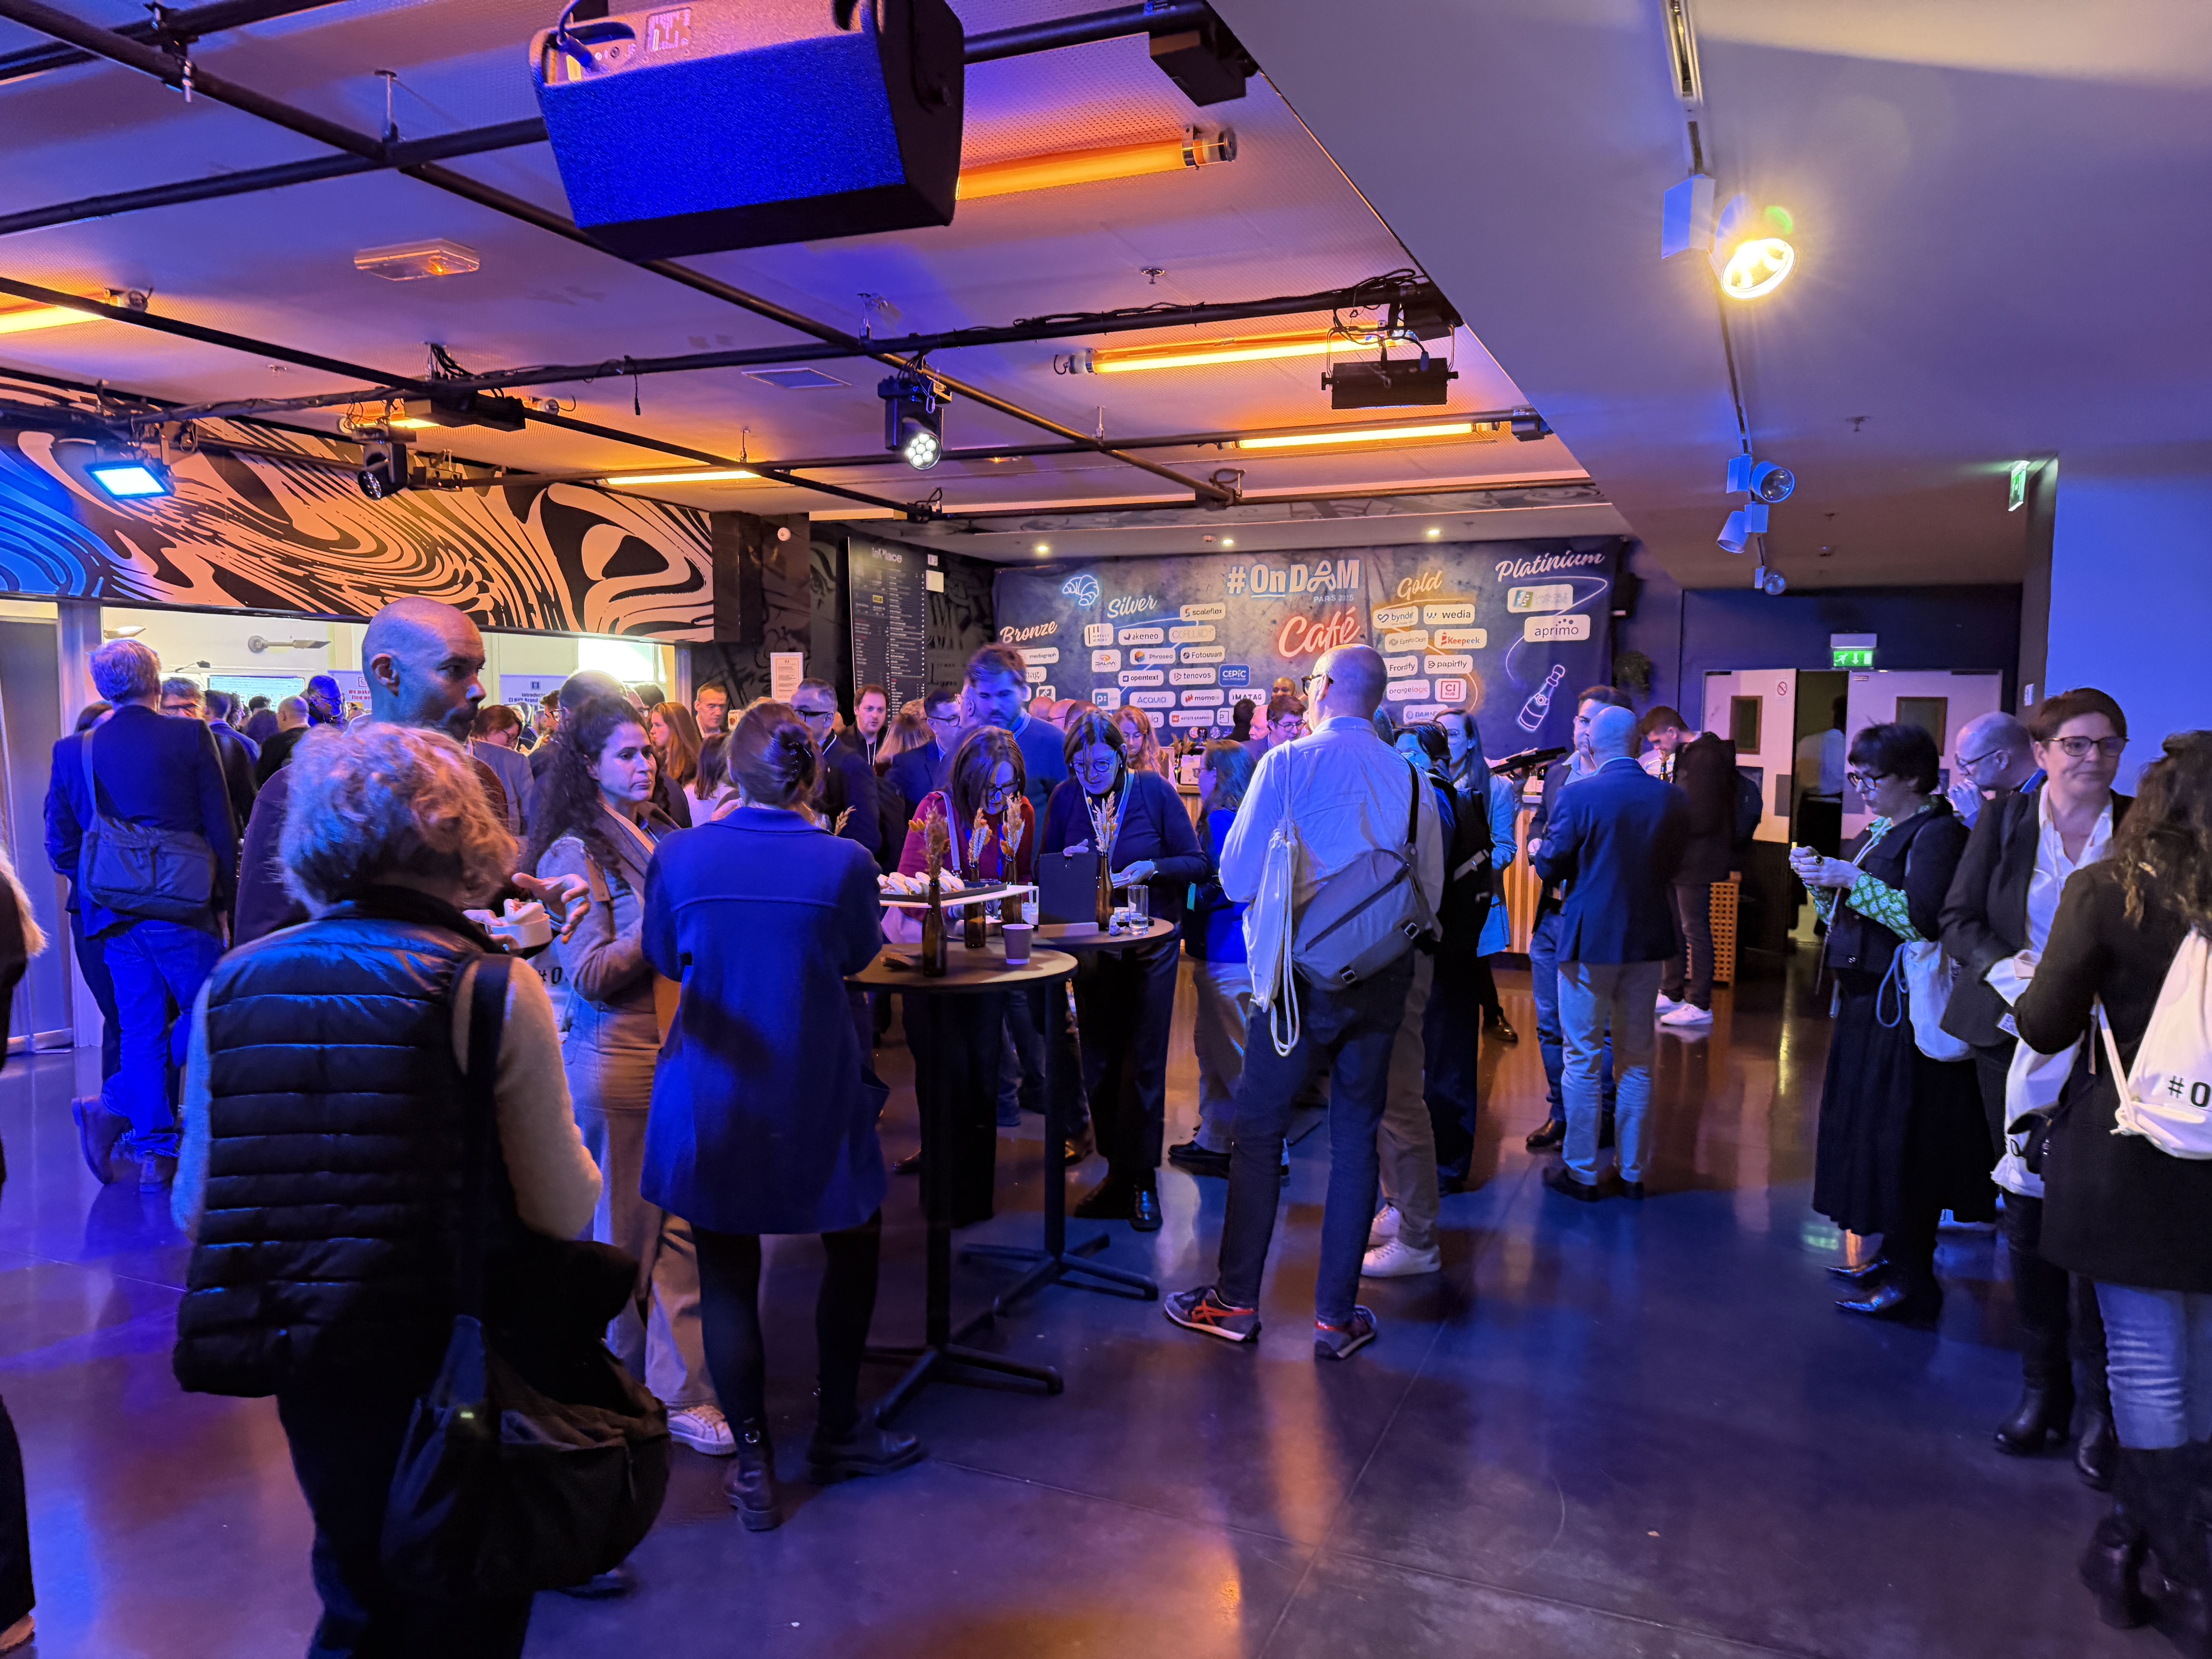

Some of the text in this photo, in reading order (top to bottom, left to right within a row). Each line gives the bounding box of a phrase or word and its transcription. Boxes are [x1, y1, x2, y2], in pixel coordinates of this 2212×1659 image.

[1496, 550, 1605, 582] Platinium
[1397, 570, 1443, 600] Gold
[1107, 595, 1157, 618] Silver
[1192, 608, 1222, 616] scaleflex
[1442, 610, 1471, 618] wedia
[1000, 621, 1058, 643] Bronze
[1278, 606, 1360, 658] Café
[1535, 624, 1579, 638] aprimo
[1448, 637, 1480, 646] Keepeek
[1437, 660, 1467, 668] papirfly
